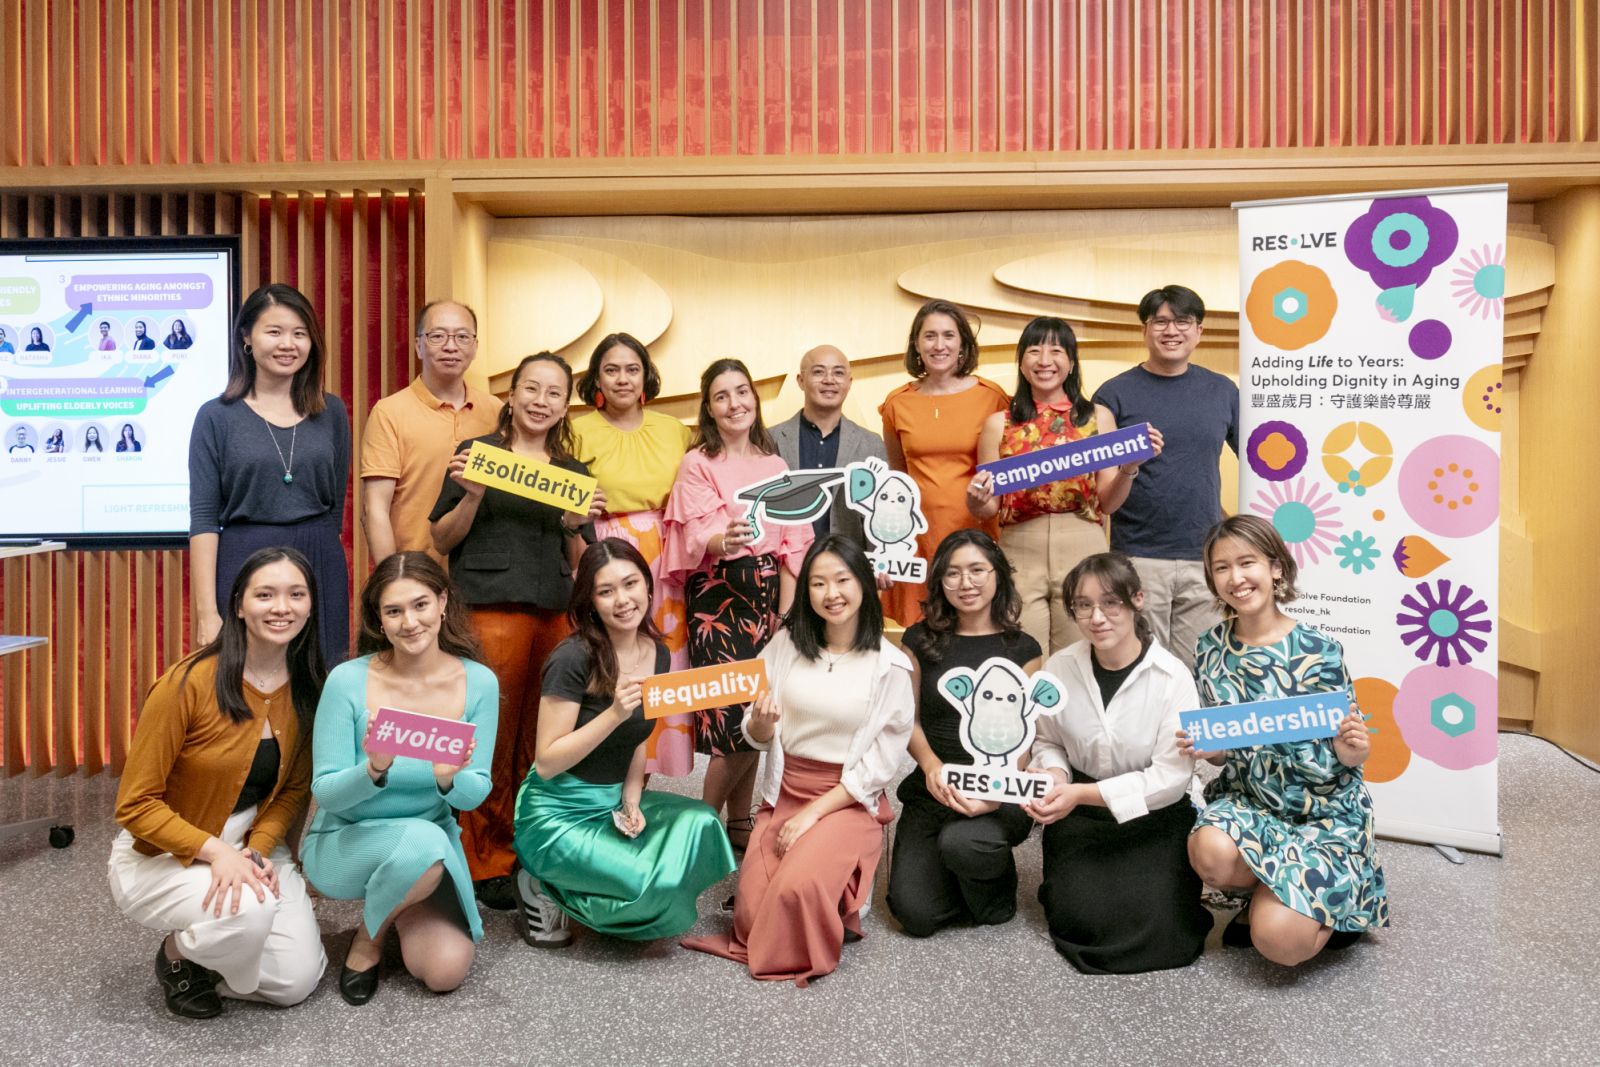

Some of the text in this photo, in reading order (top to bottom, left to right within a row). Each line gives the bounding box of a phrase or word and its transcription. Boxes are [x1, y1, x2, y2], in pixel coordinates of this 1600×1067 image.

[73, 281, 206, 292] EMPOWERING AGING AMONGST
[96, 292, 182, 302] ETHNIC MINORITIES
[1251, 355, 1404, 371] Adding Life to Years:
[1251, 373, 1460, 390] Upholding Dignity in Aging
[6, 385, 143, 396] INTERGENERATIONAL LEARNING
[16, 401, 135, 411] UPLIFTING ELDERLY VOICES
[471, 453, 590, 507] #solidarity
[104, 504, 134, 513] LIGHT
[1320, 593, 1371, 605] Foundation
[1285, 606, 1331, 617] resolve_hk
[1320, 623, 1371, 635] Foundation
[647, 672, 760, 708] #equality
[1187, 703, 1345, 741] #leadership
[376, 720, 464, 755] #voice
